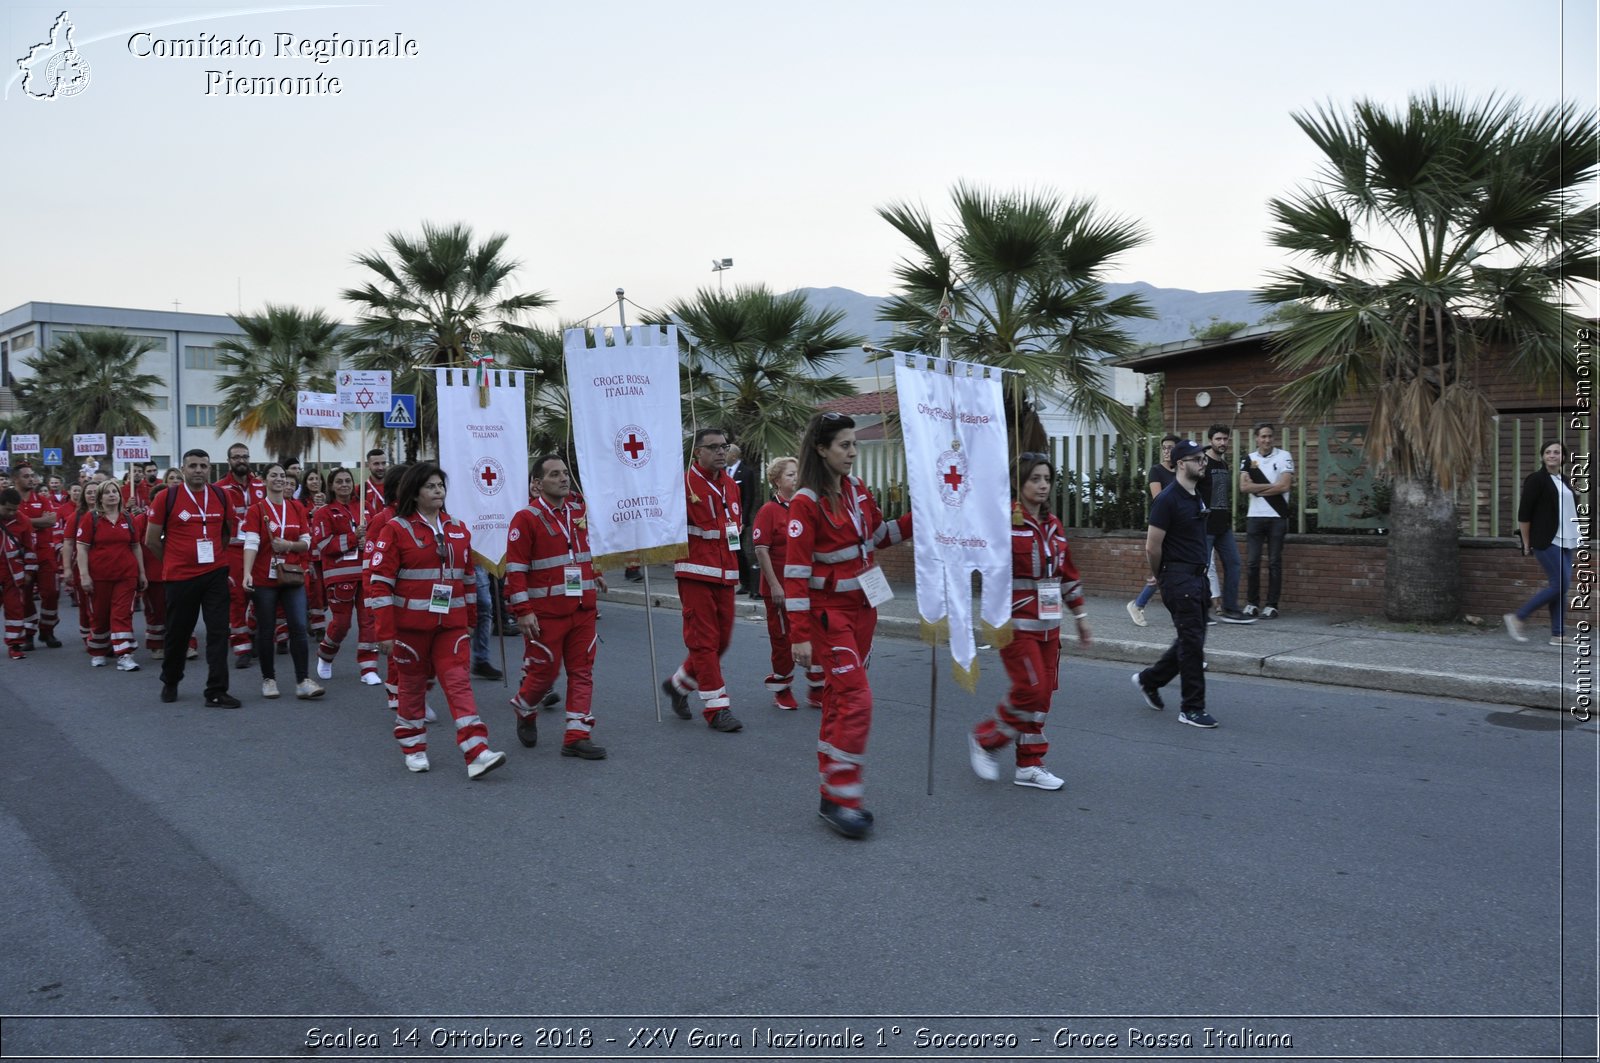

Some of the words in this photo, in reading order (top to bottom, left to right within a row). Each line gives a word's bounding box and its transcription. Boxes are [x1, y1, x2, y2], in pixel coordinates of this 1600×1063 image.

[593, 375, 624, 387] CROCE
[626, 375, 650, 385] ROSSA
[605, 386, 644, 398] ITALIANA
[299, 408, 341, 417] CALABRIA
[77, 443, 105, 453] ABRUZZO
[116, 448, 149, 459] UMBRIA
[617, 496, 659, 509] COMITATO
[612, 510, 642, 522] GIOIA
